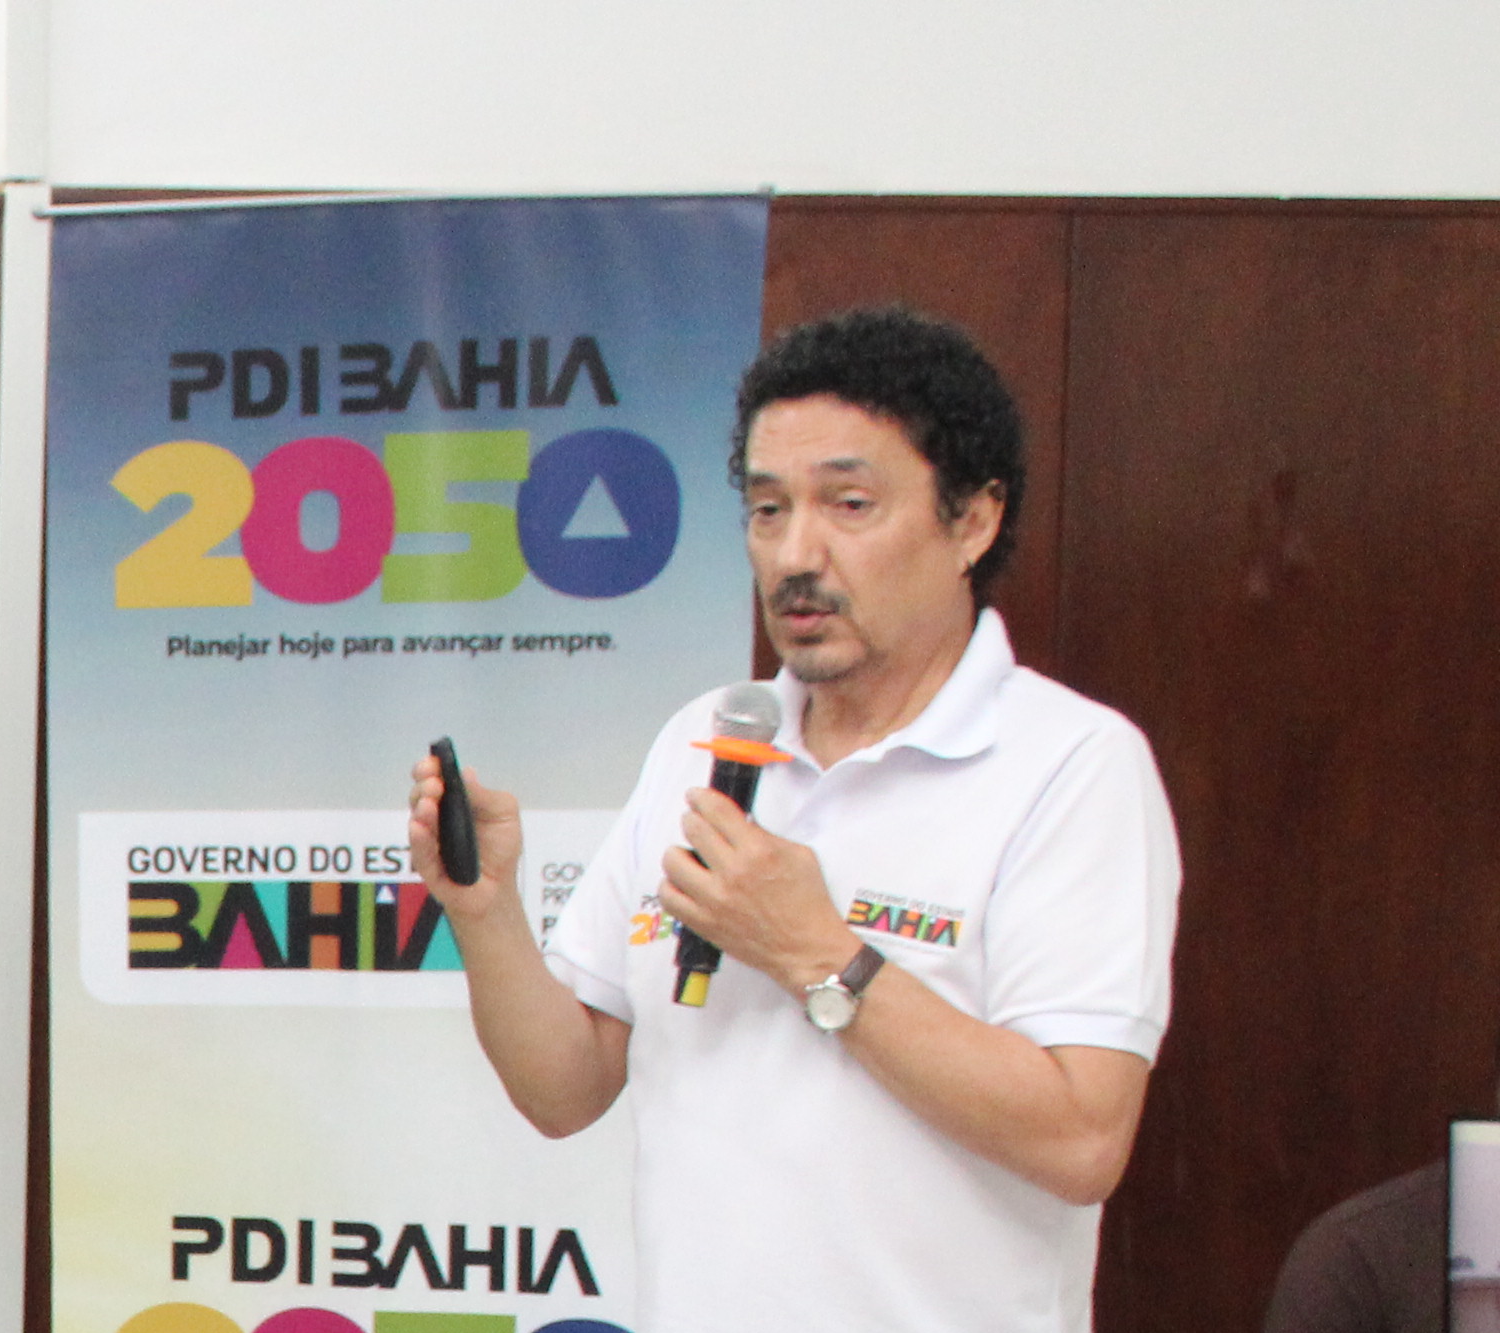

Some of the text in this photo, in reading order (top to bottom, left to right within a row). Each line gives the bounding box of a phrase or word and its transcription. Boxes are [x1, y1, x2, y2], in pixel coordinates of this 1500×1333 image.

[169, 335, 619, 421] PDI BAHIA
[110, 428, 681, 608] 2050
[167, 632, 616, 659] Planejar hoje para avançar sempre.
[128, 846, 418, 873] GOVERNO DO EST
[170, 1215, 602, 1296] PDI BAHIA
